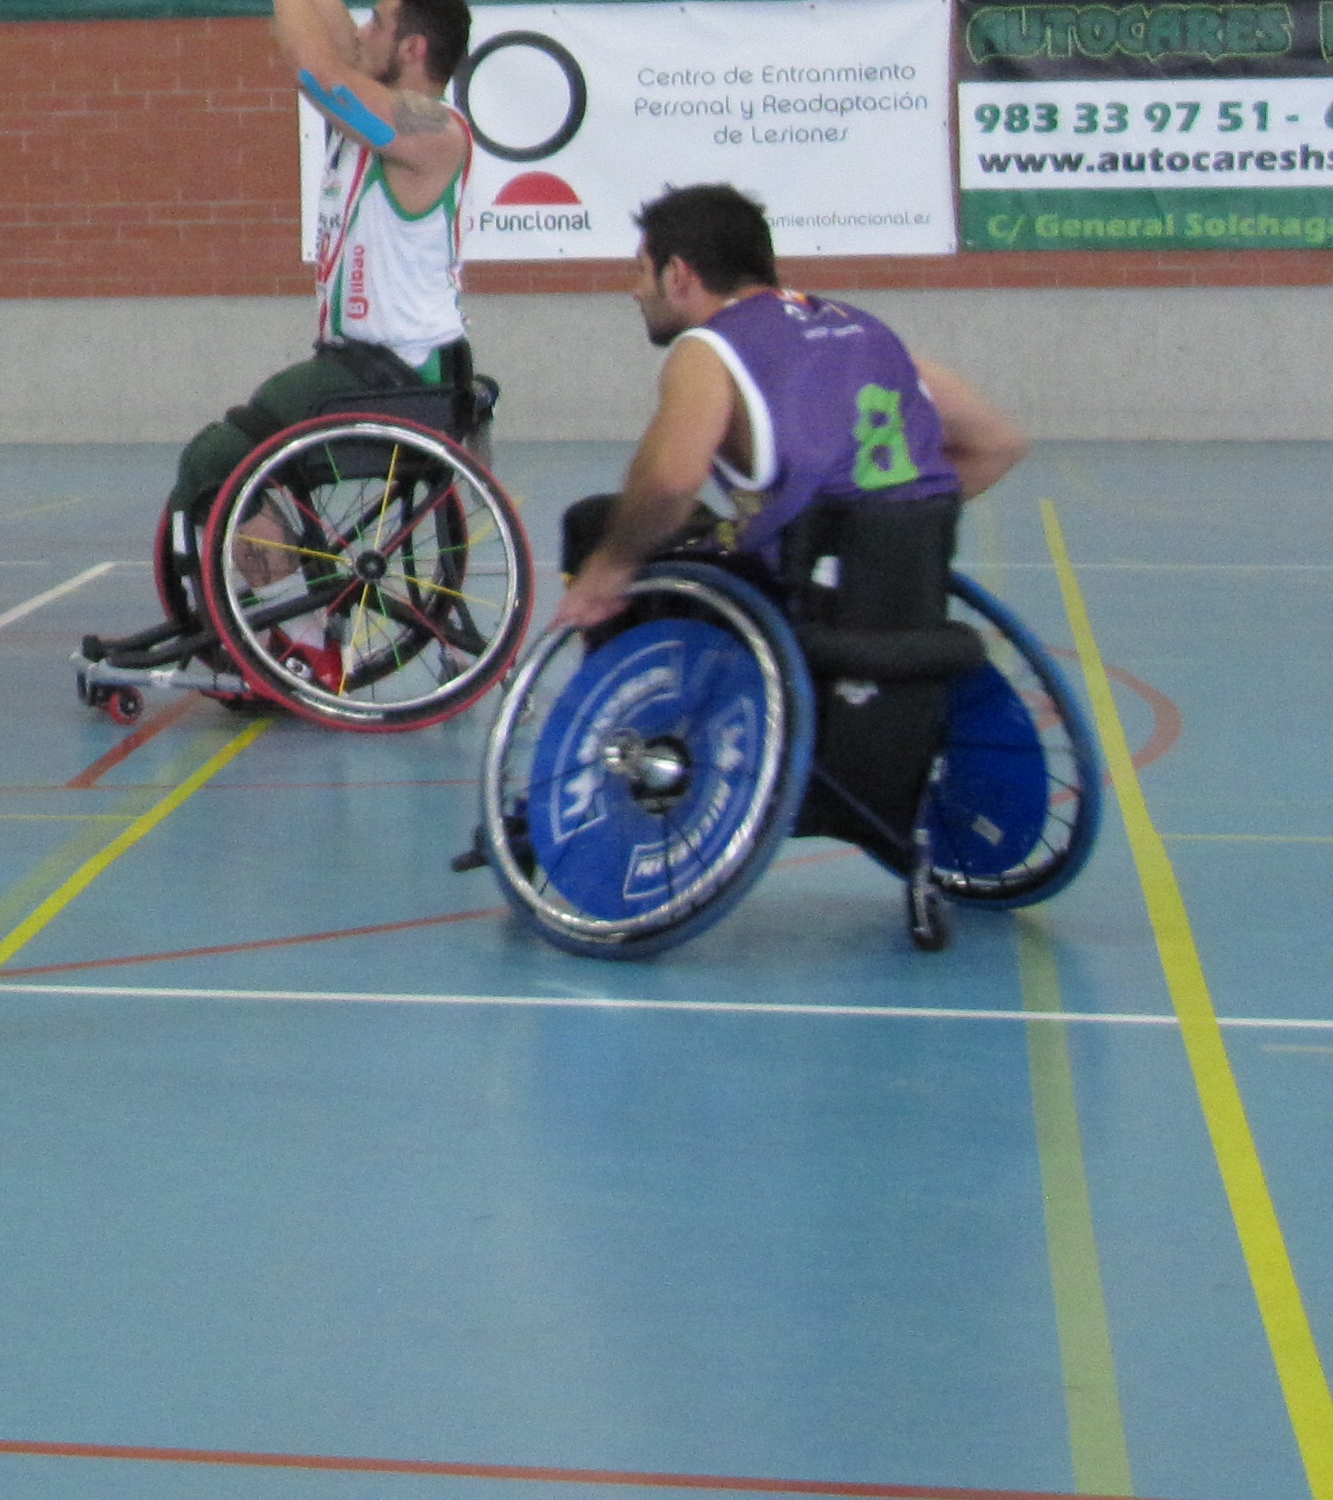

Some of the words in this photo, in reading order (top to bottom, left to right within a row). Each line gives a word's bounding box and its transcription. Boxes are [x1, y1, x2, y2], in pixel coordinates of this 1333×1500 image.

[637, 67, 716, 87] Centro
[724, 65, 754, 85] de
[762, 62, 916, 85] Entranmiento
[633, 95, 733, 117] Personal
[740, 100, 755, 121] y
[762, 92, 929, 117] Readaptación
[974, 102, 1059, 134] 983
[1073, 102, 1130, 134] 33
[1143, 101, 1202, 133] 97
[1217, 100, 1270, 133] 51
[713, 125, 744, 146] de
[751, 124, 850, 145] Lesiones
[479, 209, 592, 233] Funcional
[987, 214, 1027, 245] C/
[1034, 212, 1175, 239] General
[853, 382, 921, 491] 8
